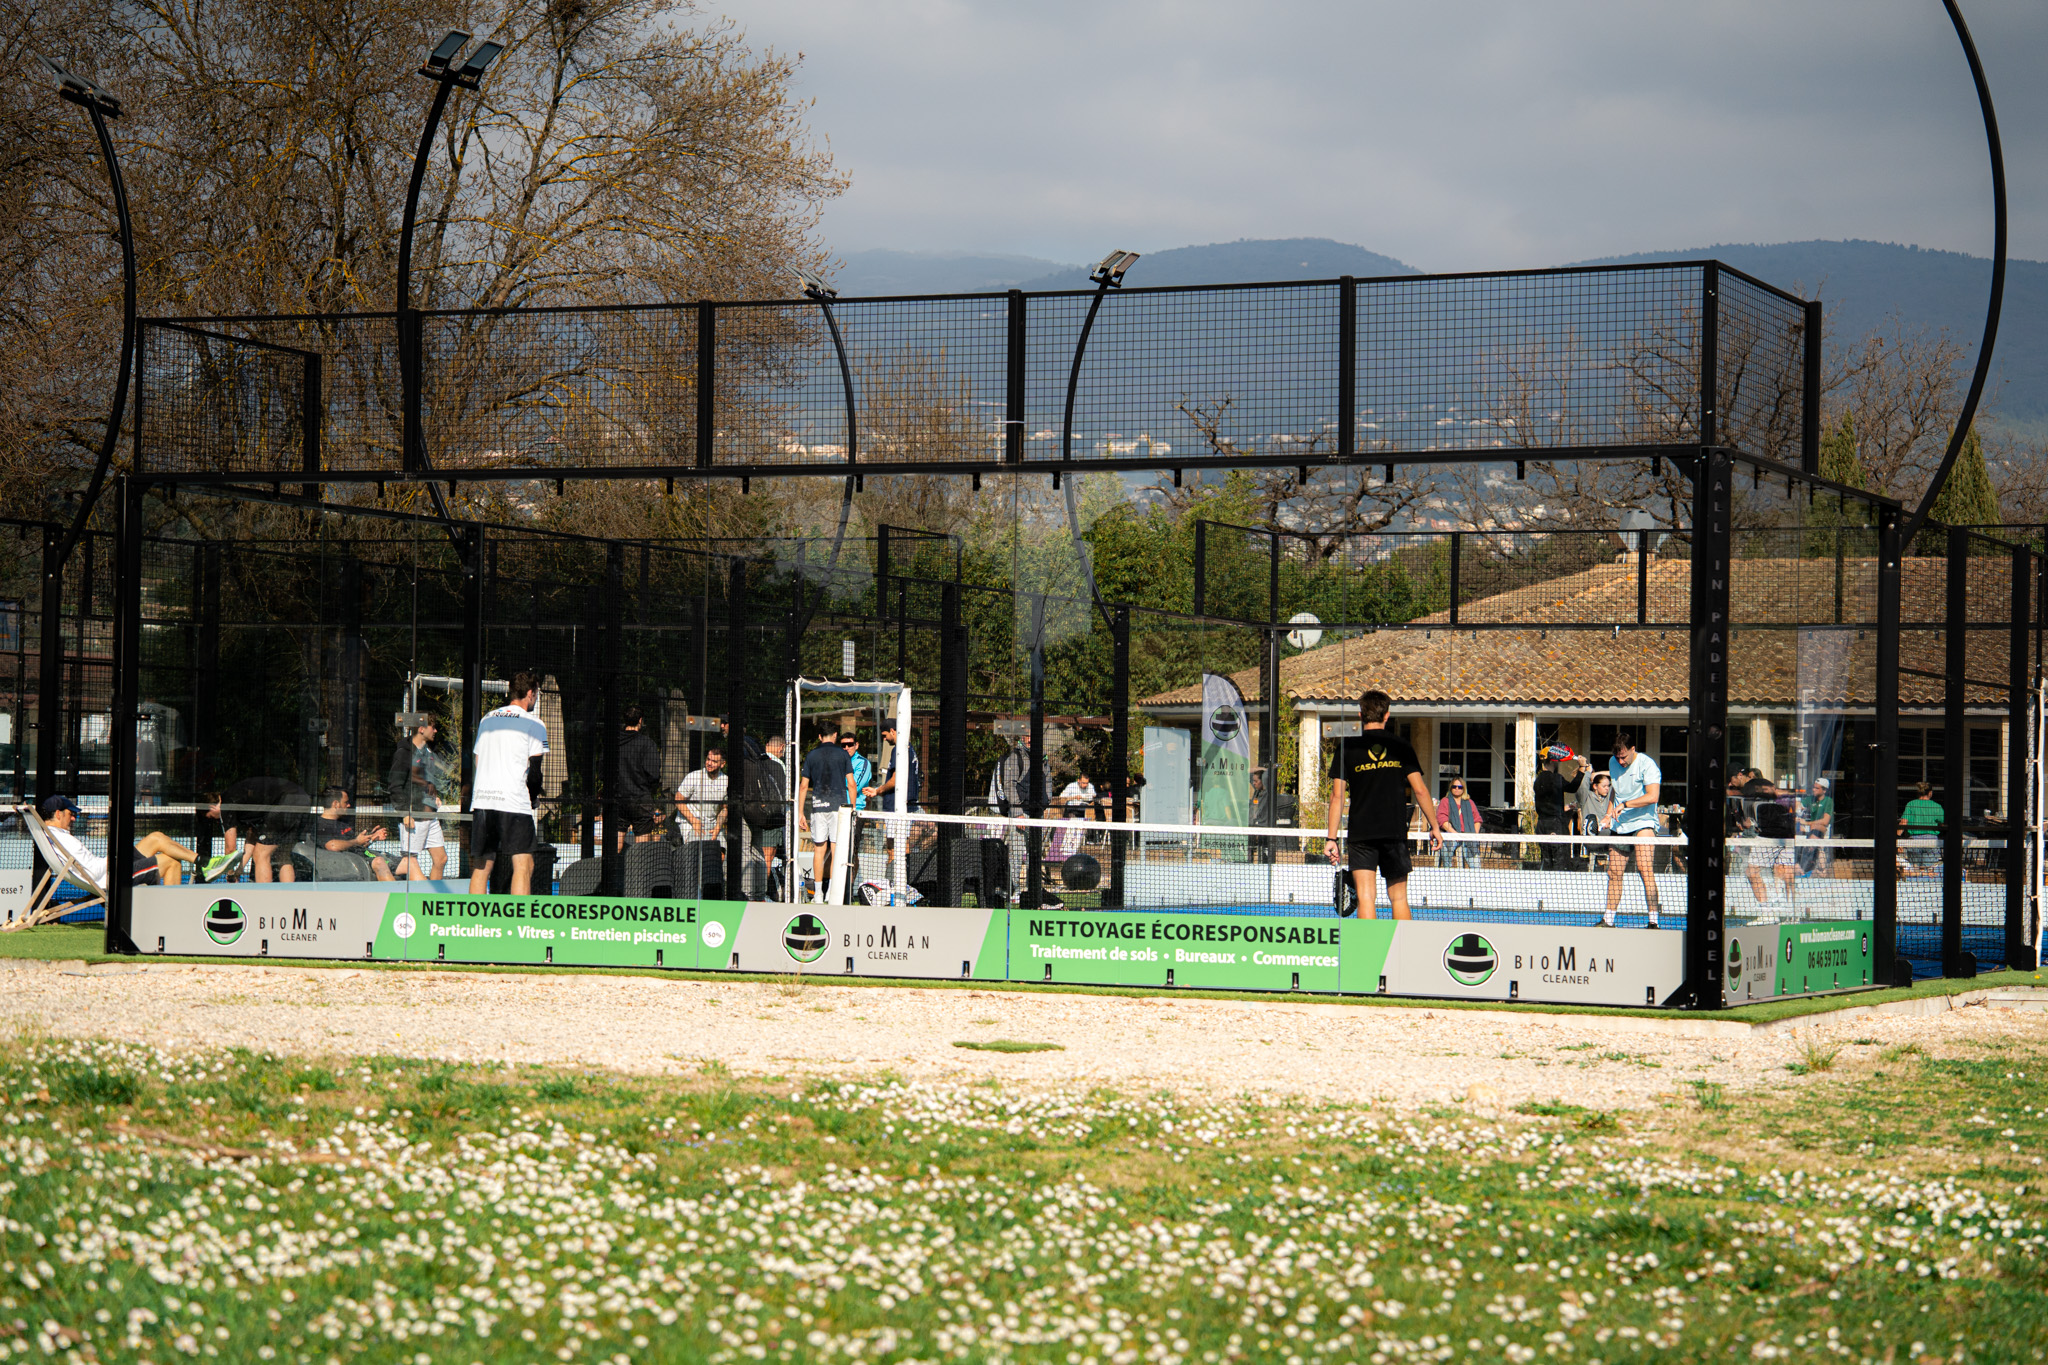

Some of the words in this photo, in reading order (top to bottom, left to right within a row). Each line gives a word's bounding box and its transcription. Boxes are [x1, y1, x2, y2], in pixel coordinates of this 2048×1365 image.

[1713, 480, 1724, 533] ALL
[1711, 559, 1724, 590] IN
[1710, 611, 1722, 703] PADEL
[1354, 762, 1377, 773] CASA
[1377, 760, 1402, 769] PADEL
[1708, 758, 1719, 811] ALL
[1707, 837, 1719, 868] IN
[422, 900, 526, 918] NETTOYAGE
[530, 899, 697, 924] ÉCORESPONSABLE
[281, 932, 317, 942] CLEANER
[429, 922, 502, 939] Particuliers
[517, 925, 555, 940] Vitres
[570, 927, 631, 943] Entretien
[633, 928, 687, 946] piscines
[1029, 919, 1146, 940] NETTOYAGE
[1151, 919, 1340, 945] ÉCORESPONSABLE
[1707, 889, 1719, 981] PADEL
[1799, 927, 1856, 944] www.biomancleaner.com
[867, 950, 909, 961] CLEANER
[1029, 943, 1107, 962] Traitement
[1109, 945, 1127, 961] de
[1130, 946, 1158, 963] sols
[1175, 948, 1237, 965] Bureaux
[1252, 950, 1340, 968] Commerces
[1807, 951, 1815, 969] 06
[1816, 951, 1823, 968] 46
[1824, 950, 1831, 968] 59
[1832, 949, 1840, 967] 72
[1840, 949, 1848, 966] 02
[1542, 974, 1590, 985] CLEANER
